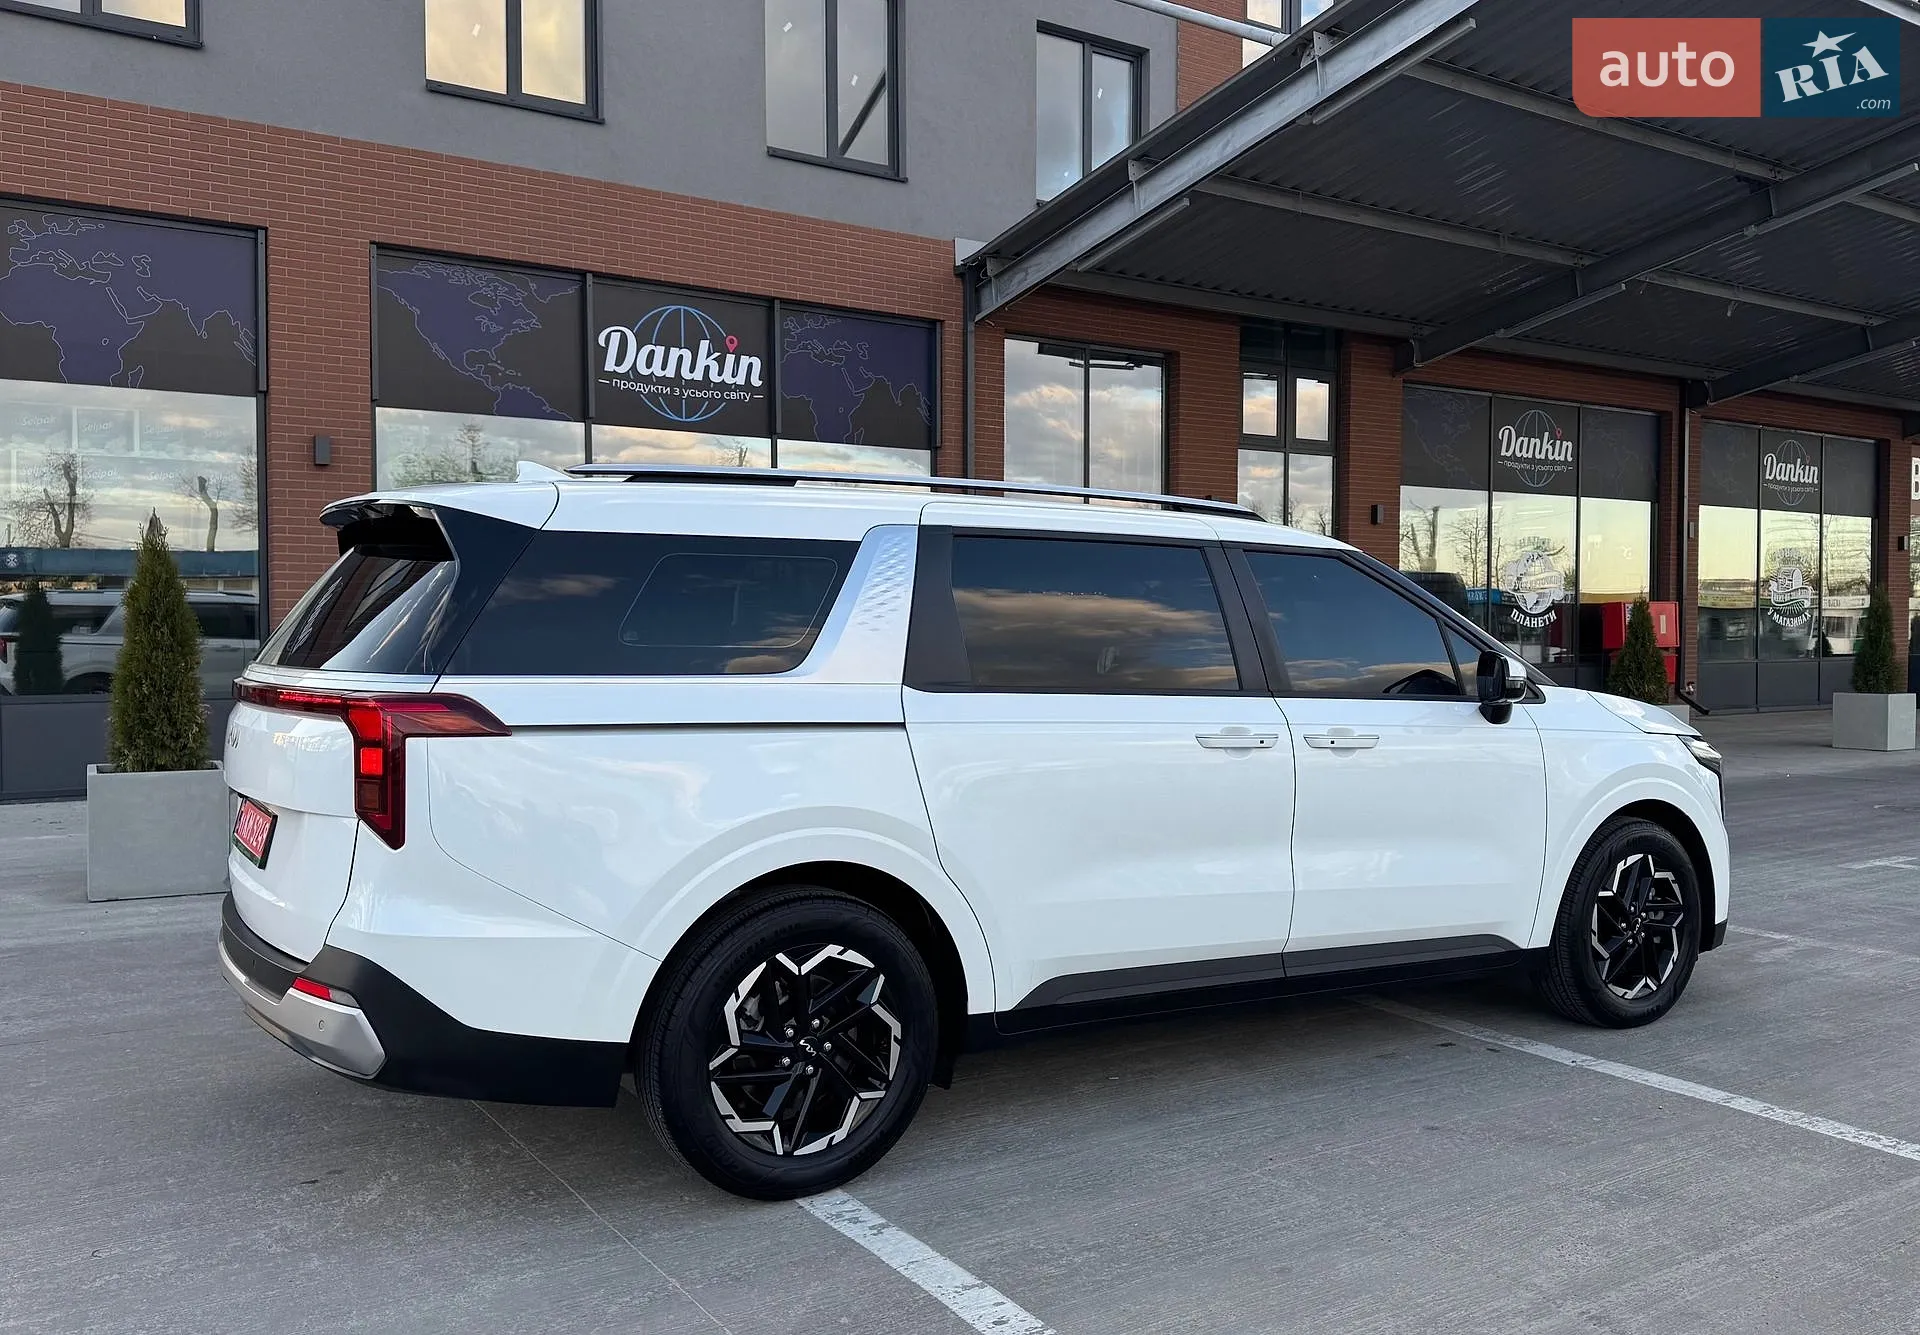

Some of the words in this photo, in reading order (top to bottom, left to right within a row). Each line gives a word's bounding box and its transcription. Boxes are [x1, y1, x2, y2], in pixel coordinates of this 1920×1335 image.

[597, 325, 764, 388] Dankin
[612, 378, 671, 395] продукти
[673, 386, 680, 396] з
[682, 388, 722, 400] усього
[723, 390, 752, 402] світу
[1498, 425, 1573, 462] Dankin
[1763, 452, 1818, 484] Dankin
[1510, 608, 1557, 628] ПЛАНЕТИ
[1772, 609, 1812, 627] МАГАЗИНАХ
